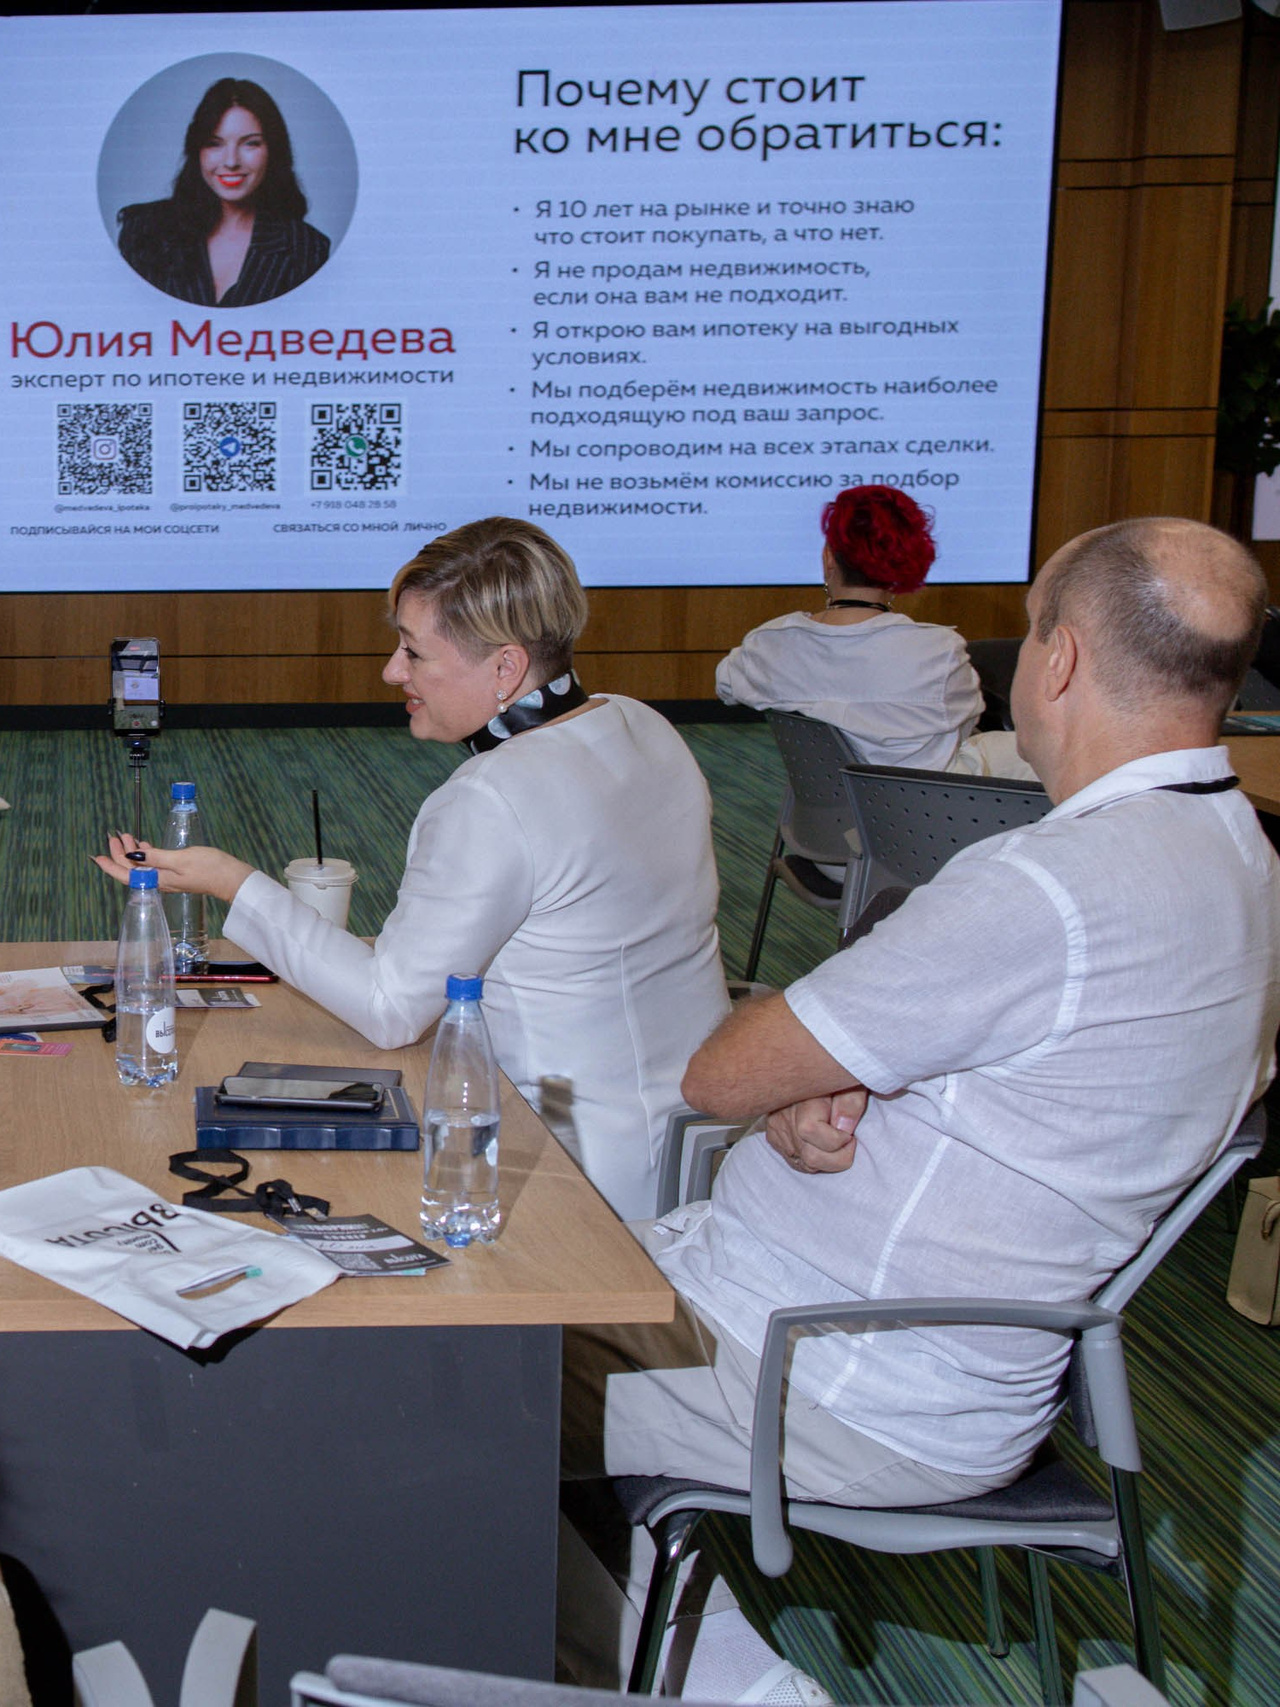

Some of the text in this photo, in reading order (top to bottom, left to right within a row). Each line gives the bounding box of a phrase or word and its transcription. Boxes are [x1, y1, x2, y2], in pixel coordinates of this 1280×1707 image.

[517, 69, 866, 117] Почему стоит
[515, 114, 1002, 162] ко мне обратиться:
[536, 199, 915, 222] Я 10 лет на рынке и точно знаю
[534, 227, 884, 248] что стоит покупать, а что нет.
[534, 260, 870, 283] Я не продам недвижимость,
[533, 288, 848, 306] если она вам не подходит.
[11, 319, 456, 362] Юлия Медведева
[532, 320, 959, 343] Я открою вам ипотеку на выгодных
[531, 351, 646, 371] условиях.
[11, 370, 454, 392] эксперт по ипотеке и недвижимости
[532, 376, 998, 402] Мы подберём недвижимость наиболее
[530, 407, 884, 428] подходящую под ваш запрос.
[530, 439, 994, 462] Мы сопроводим на всех этапах сделки.
[530, 468, 960, 490] Мы не возьмём комиссию за подбор
[528, 502, 708, 519] недвижимости.
[10, 524, 220, 536] ПОДПИСЫВАЙСЯ НА МОИ СОЦСЕТИ
[272, 521, 448, 533] СВЯЗАТЬСЯ СО МНОЙ ЛИЧНО
[44, 1203, 181, 1254] ВЫСОТА
